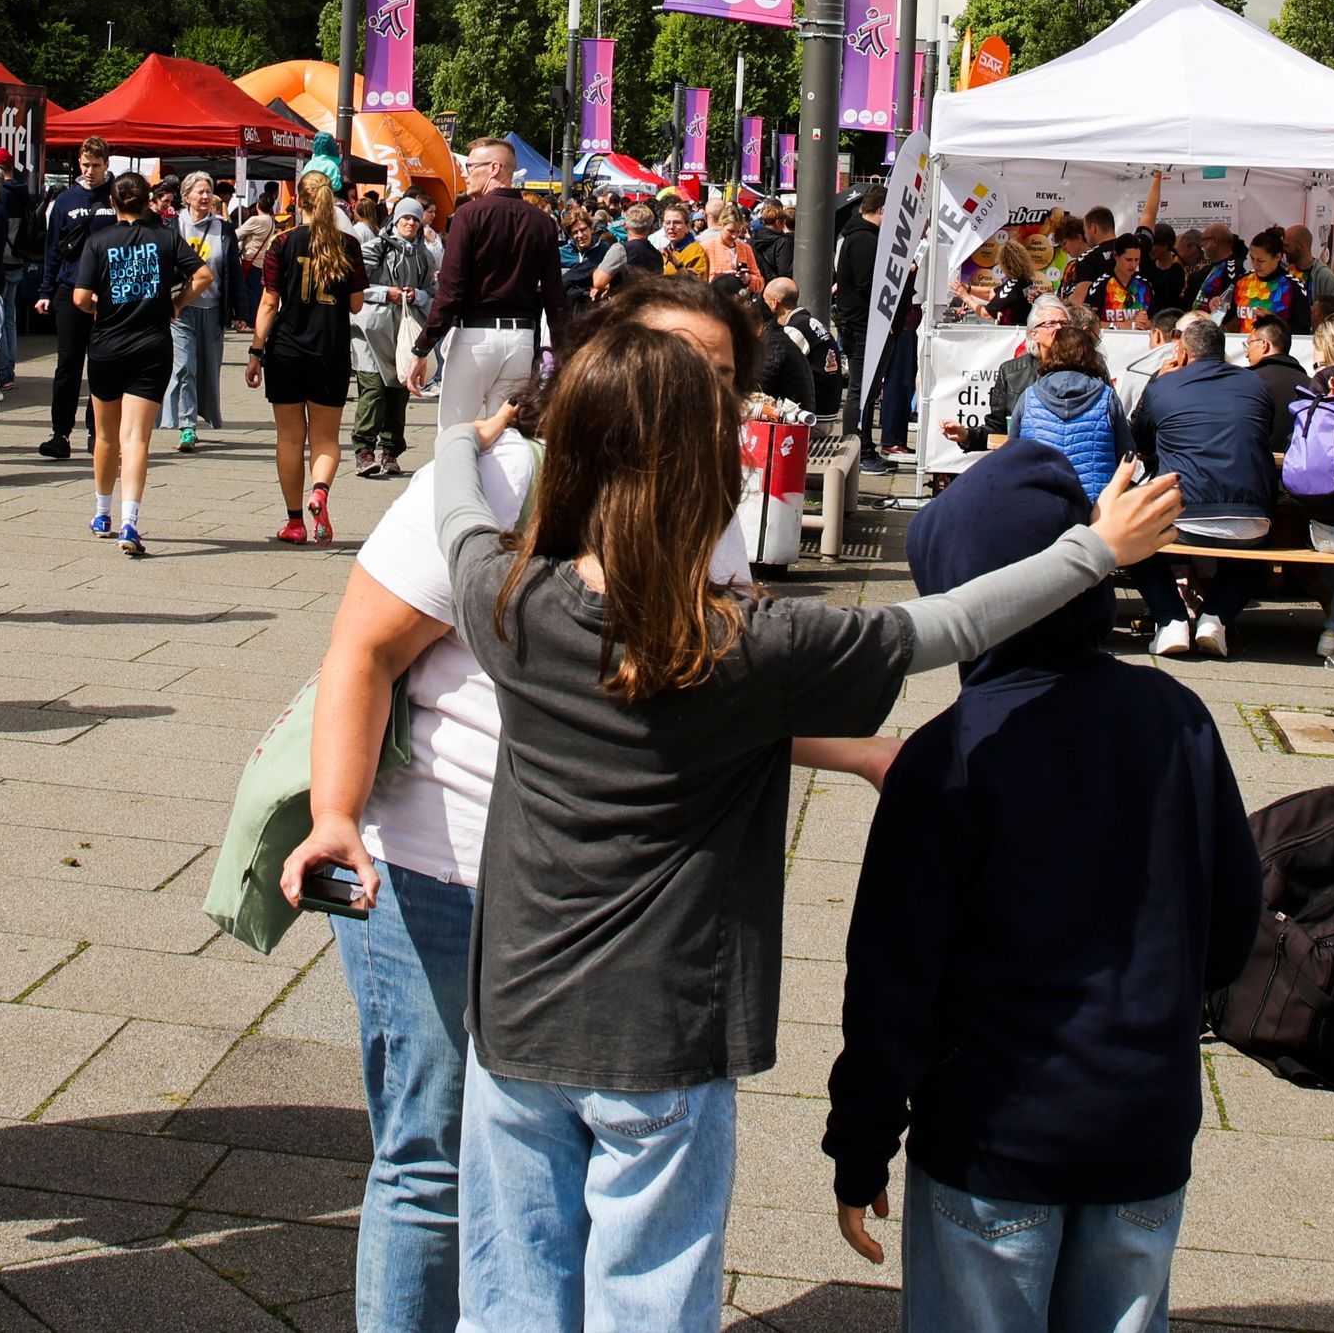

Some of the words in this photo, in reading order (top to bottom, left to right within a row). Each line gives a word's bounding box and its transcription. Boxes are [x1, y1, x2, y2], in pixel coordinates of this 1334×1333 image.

[978, 53, 1003, 74] DAK
[272, 130, 294, 148] Herzlich
[1035, 192, 1059, 200] REWE
[970, 193, 998, 232] GROUP
[1008, 206, 1048, 224] nbar
[107, 243, 158, 263] RUHR
[877, 186, 918, 322] REWE
[110, 264, 160, 280] BOCHUM
[111, 281, 160, 299] SPORT
[1106, 309, 1137, 322] REW
